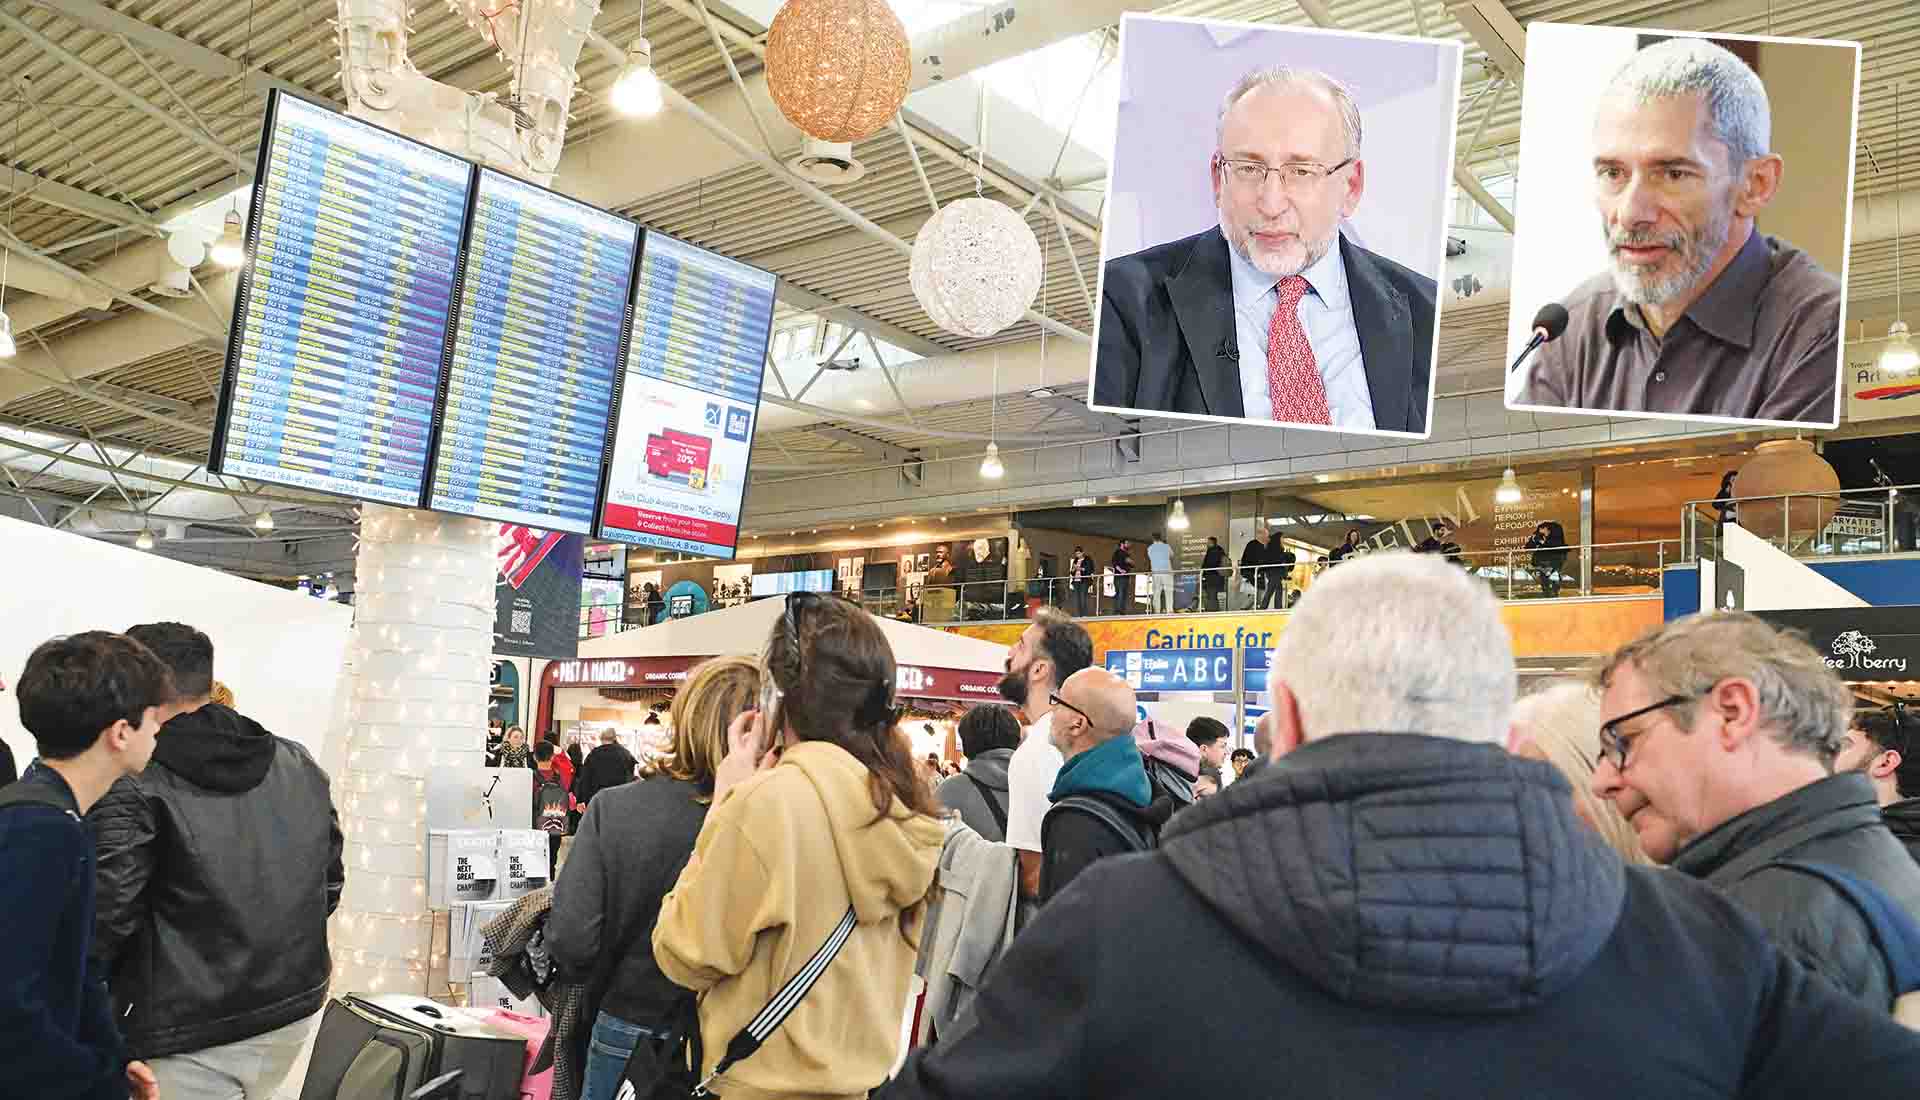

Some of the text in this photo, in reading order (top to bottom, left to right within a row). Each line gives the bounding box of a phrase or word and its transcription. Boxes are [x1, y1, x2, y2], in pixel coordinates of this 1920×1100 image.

[1146, 626, 1272, 649] Caring for
[1173, 656, 1227, 682] A B C
[1863, 656, 1907, 672] berry
[456, 873, 475, 881] GREAT
[457, 865, 472, 873] NEXT
